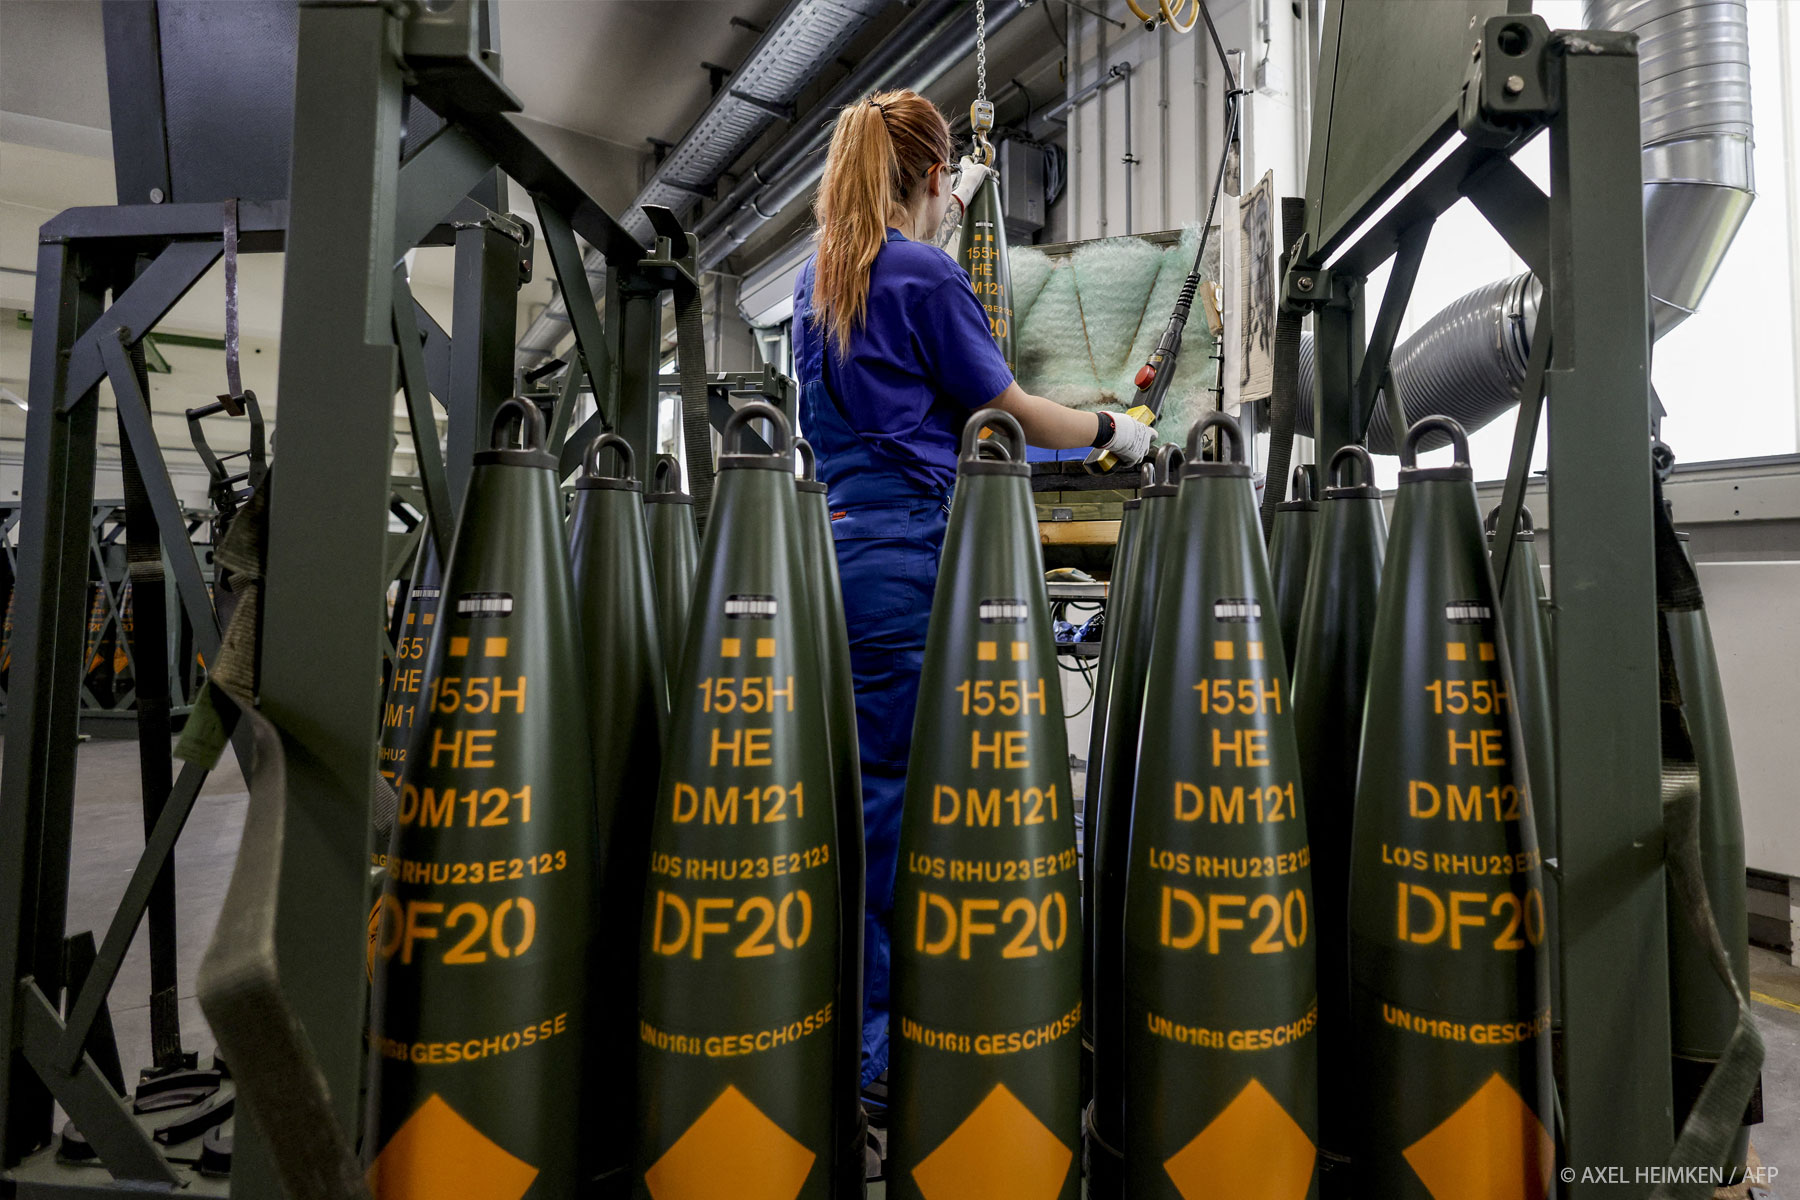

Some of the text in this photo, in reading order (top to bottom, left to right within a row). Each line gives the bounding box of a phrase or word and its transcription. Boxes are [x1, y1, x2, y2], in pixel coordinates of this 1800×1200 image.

[967, 246, 1000, 260] 155H
[972, 263, 992, 276] HE
[393, 669, 423, 692] HE
[430, 676, 527, 714] 155H
[699, 676, 794, 714] 155H
[956, 678, 1047, 716] 155H
[1192, 678, 1282, 715] 155H
[1424, 680, 1512, 715] 155H
[431, 728, 498, 768] HE
[709, 728, 773, 767] HE
[971, 730, 1029, 769] HE
[1212, 728, 1270, 767] HE
[1448, 728, 1505, 766] HE
[672, 781, 804, 825] DM121
[932, 784, 1058, 827] DM121
[1174, 781, 1296, 824] DM121
[652, 853, 682, 877] LOS
[909, 852, 946, 879] LOS
[1150, 848, 1191, 875] LOS
[1382, 843, 1428, 871] LOS
[652, 889, 813, 960] DF20
[915, 890, 1068, 960] DF20
[1159, 885, 1308, 955] DF20
[1397, 881, 1544, 951] DF20
[411, 1013, 567, 1064] GESCHOSSE
[704, 1003, 832, 1058] GESCHOSSE
